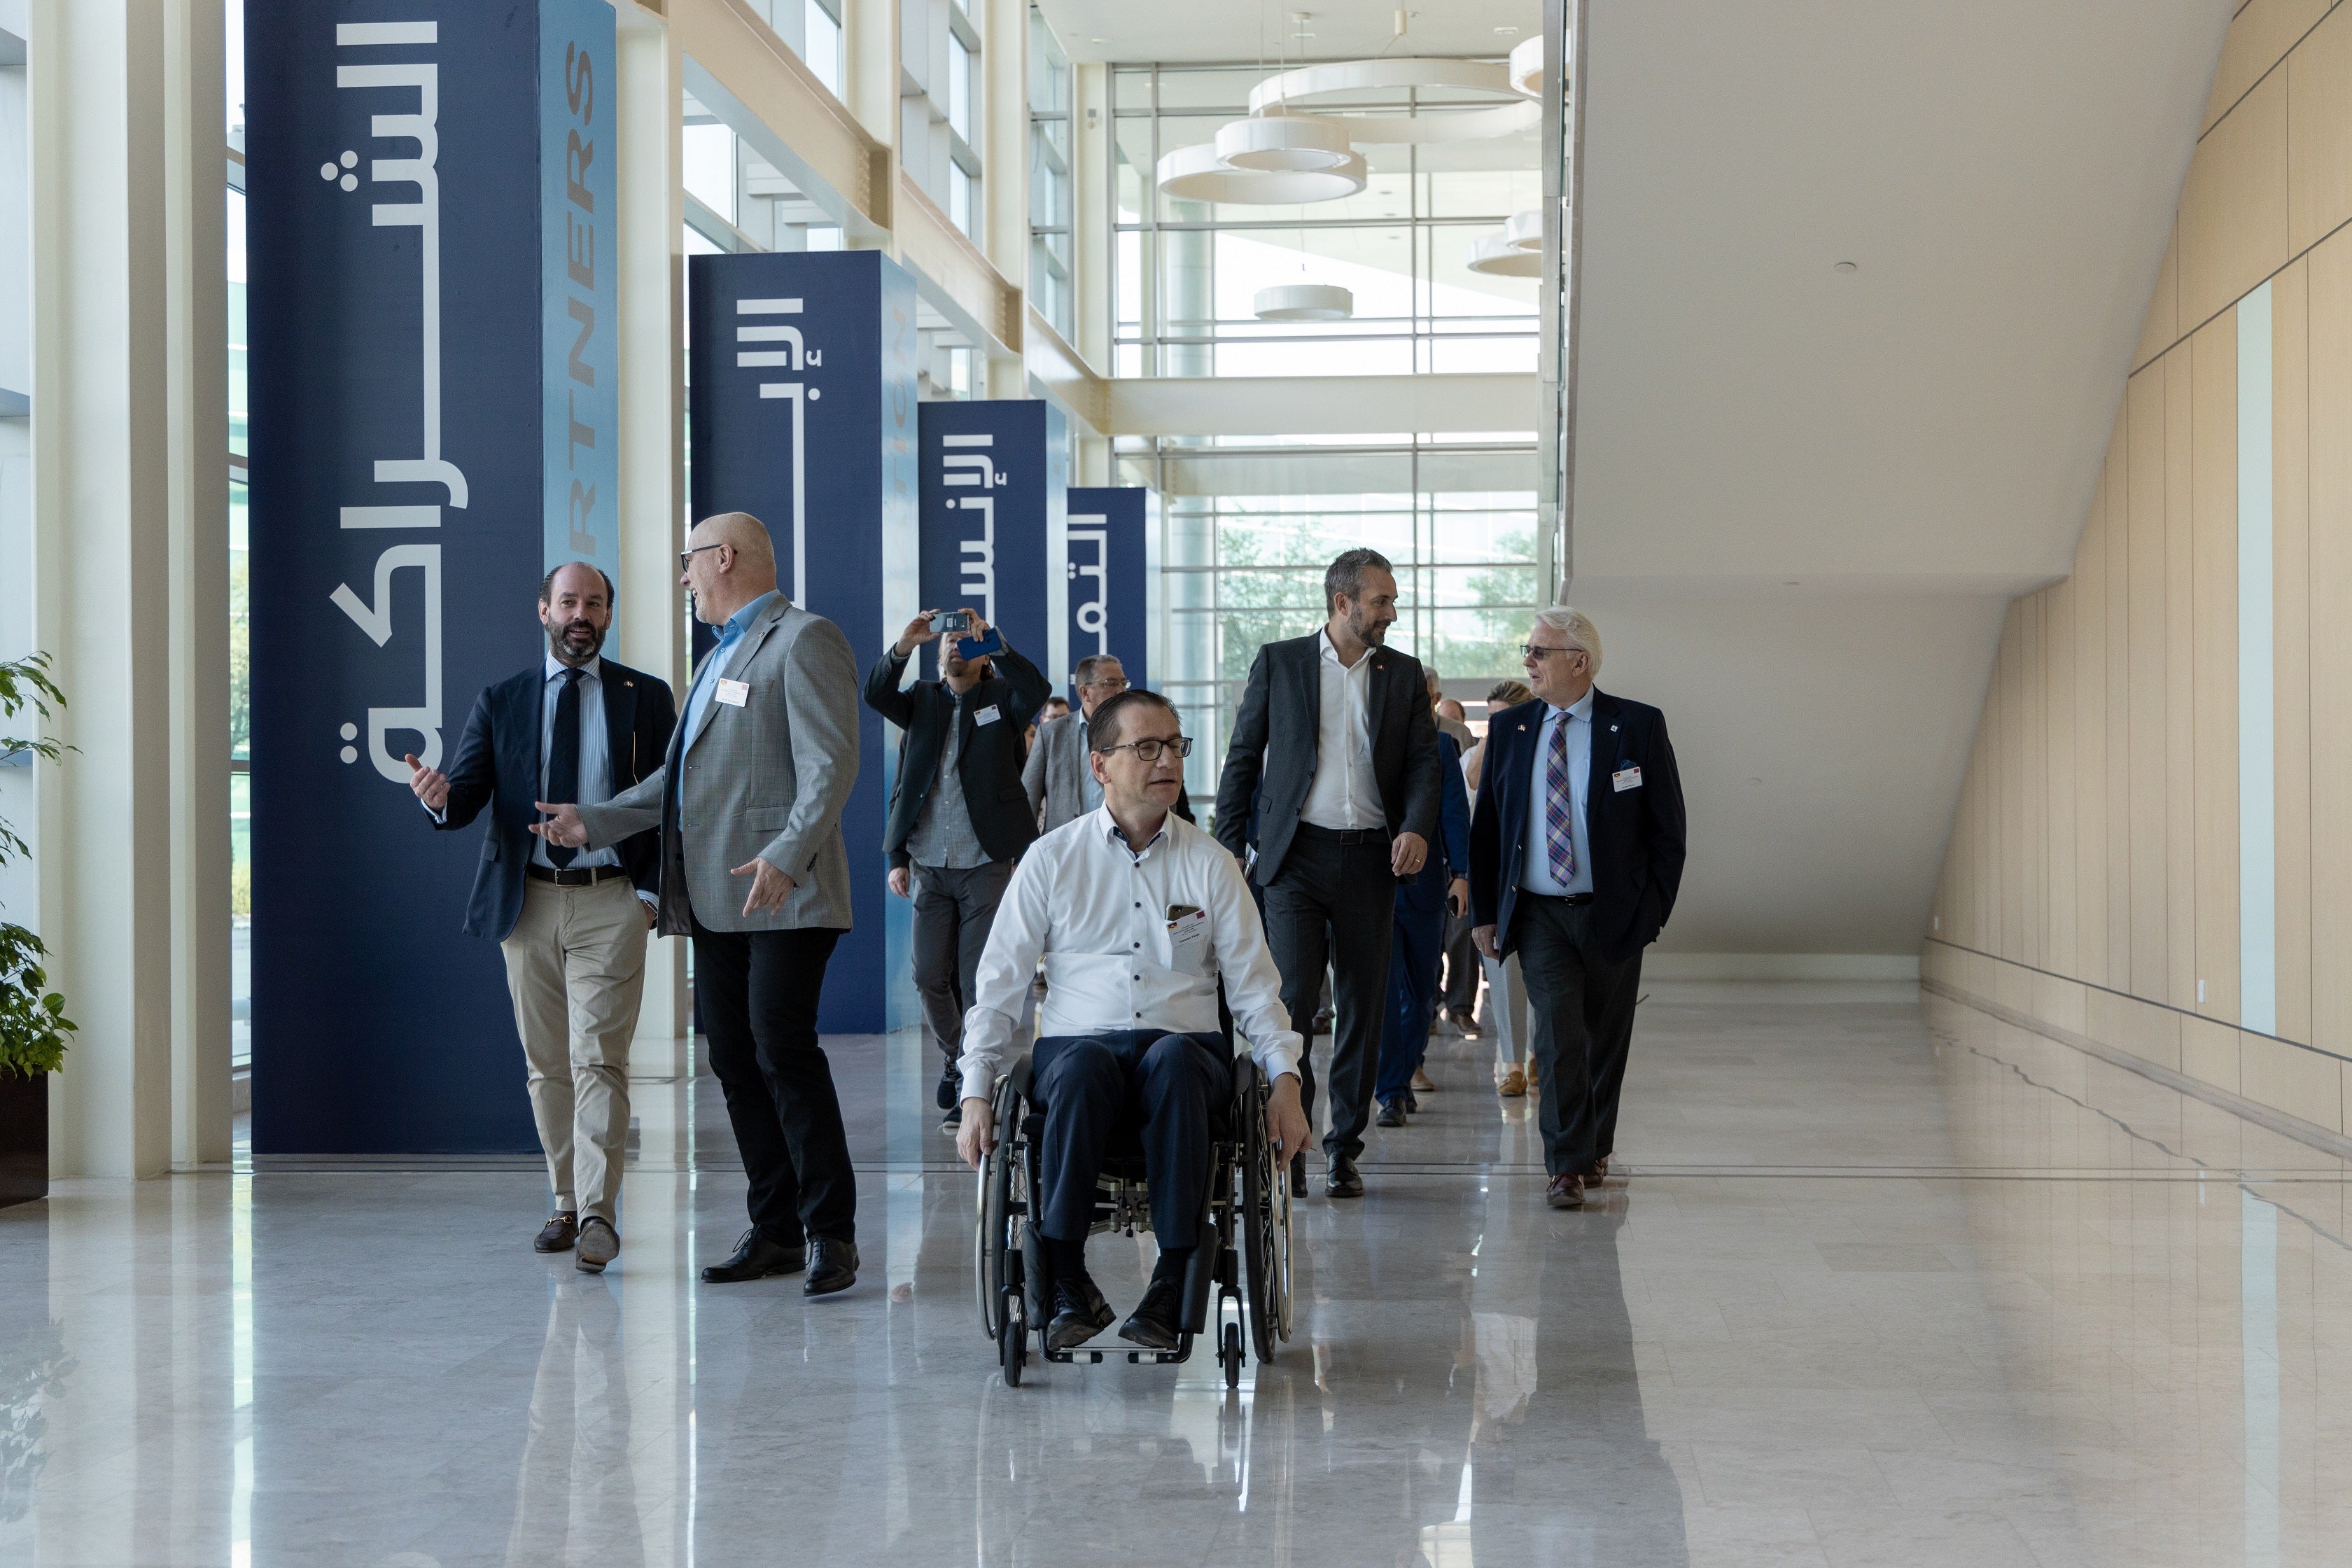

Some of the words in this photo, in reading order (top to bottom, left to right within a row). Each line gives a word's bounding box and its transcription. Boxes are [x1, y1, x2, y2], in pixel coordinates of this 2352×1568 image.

[321, 21, 469, 784] الشراكة
[565, 41, 596, 556] RTNERS
[942, 434, 1007, 628] الإنس
